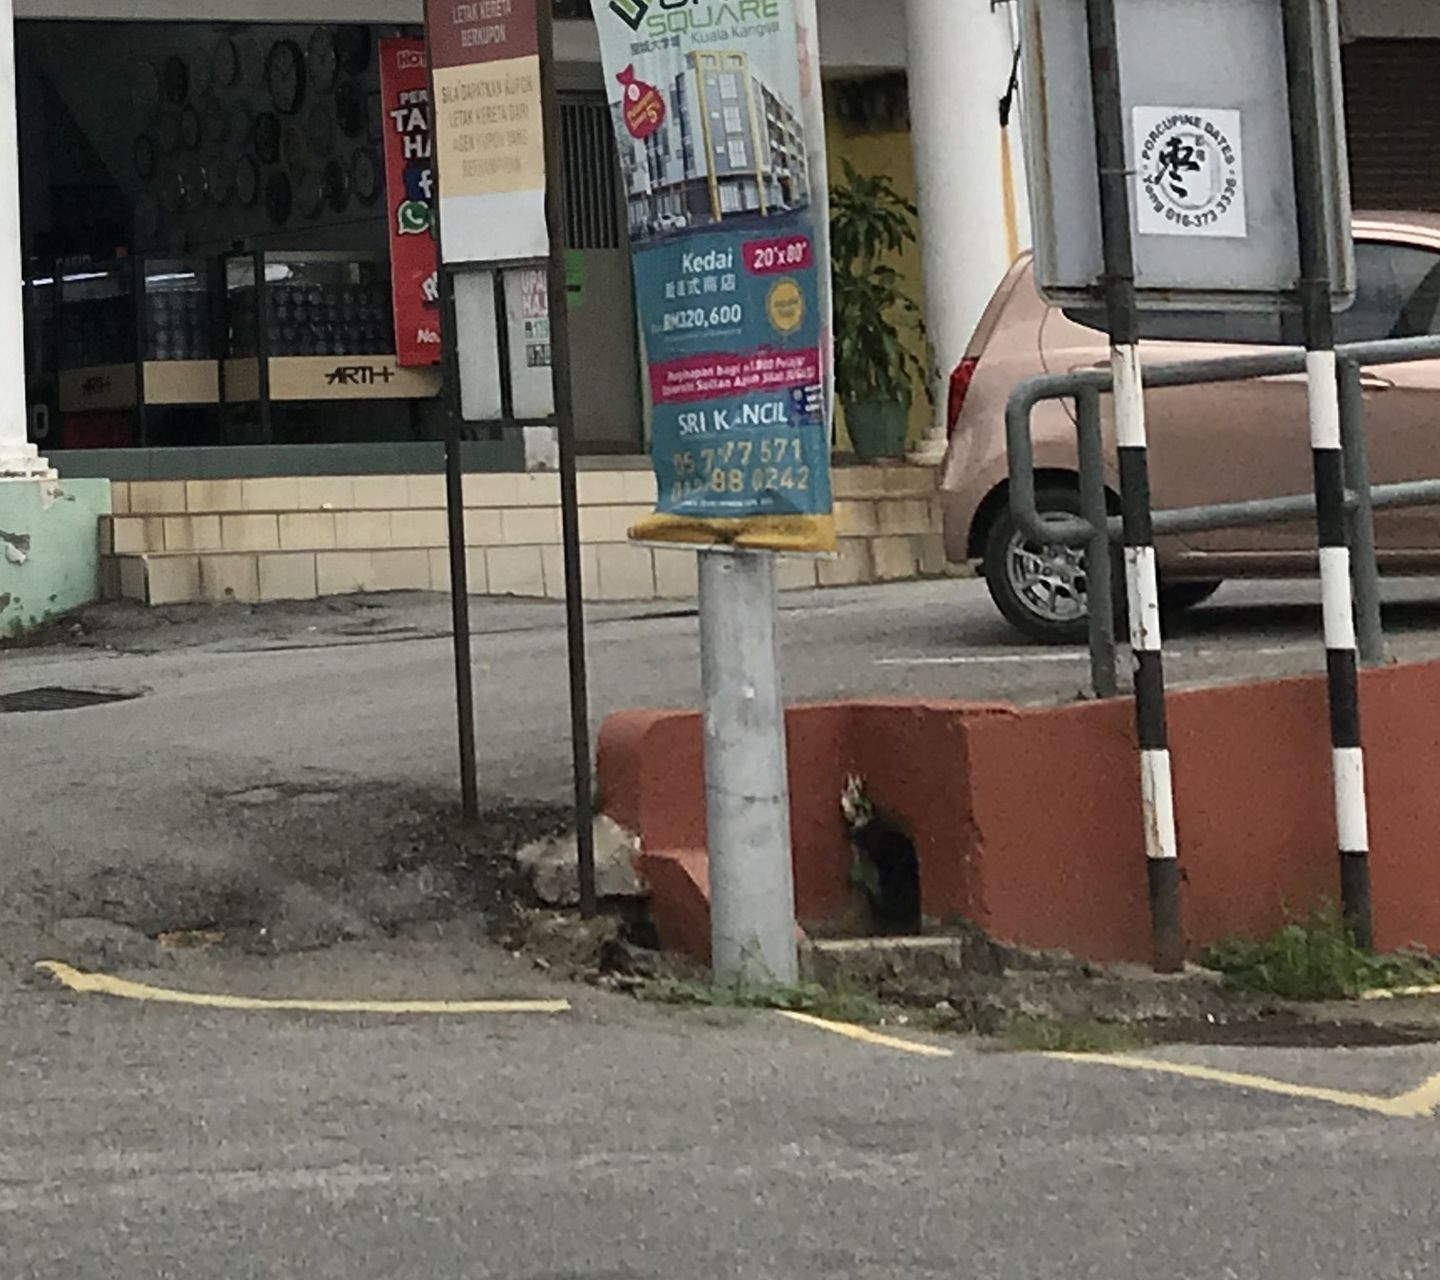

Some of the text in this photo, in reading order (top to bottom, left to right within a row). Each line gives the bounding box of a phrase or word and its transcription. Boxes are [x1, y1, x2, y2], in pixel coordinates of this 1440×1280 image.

[690, 26, 729, 45] Kuala
[1204, 122, 1235, 165] DATES
[682, 247, 734, 274] Kedai
[678, 410, 706, 437] SRI
